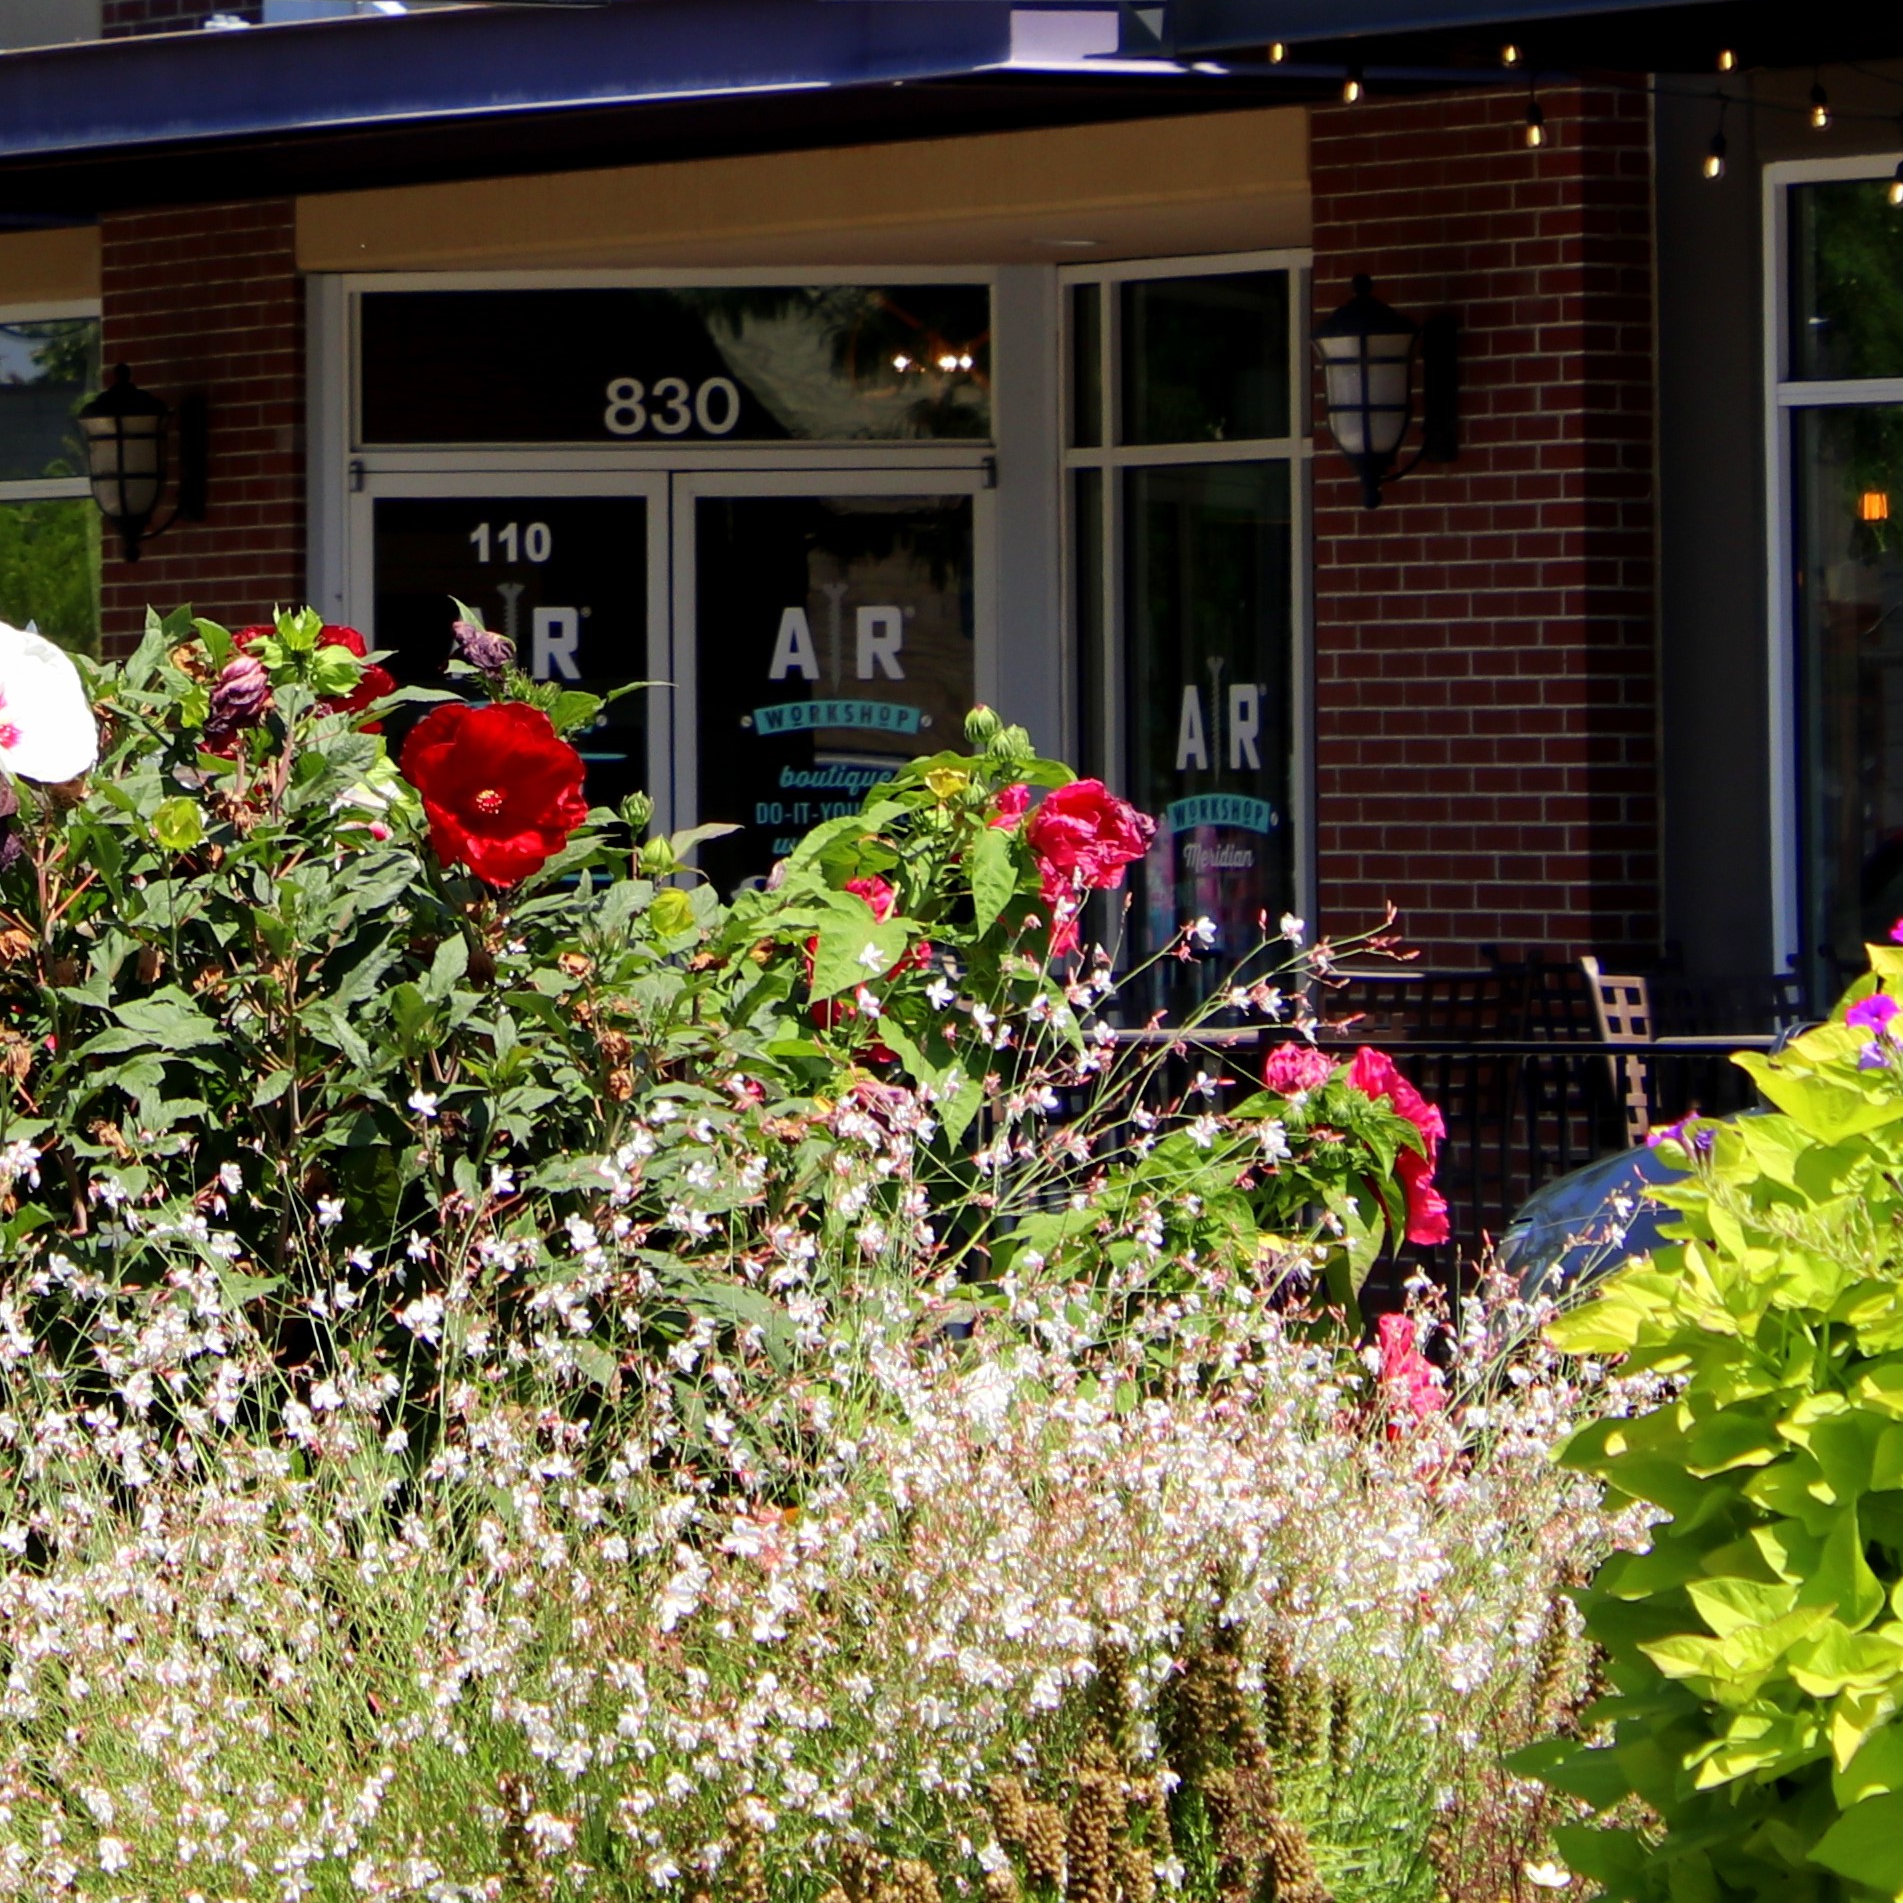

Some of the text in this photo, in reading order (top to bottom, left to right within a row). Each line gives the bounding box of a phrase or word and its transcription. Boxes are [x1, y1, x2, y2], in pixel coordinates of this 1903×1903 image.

[605, 377, 739, 434] 830
[470, 522, 552, 562] 110
[764, 703, 910, 727] WORKSHOP
[779, 765, 891, 795] boutique
[1173, 798, 1264, 827] WORKSHOP
[1183, 843, 1254, 872] Meridian
